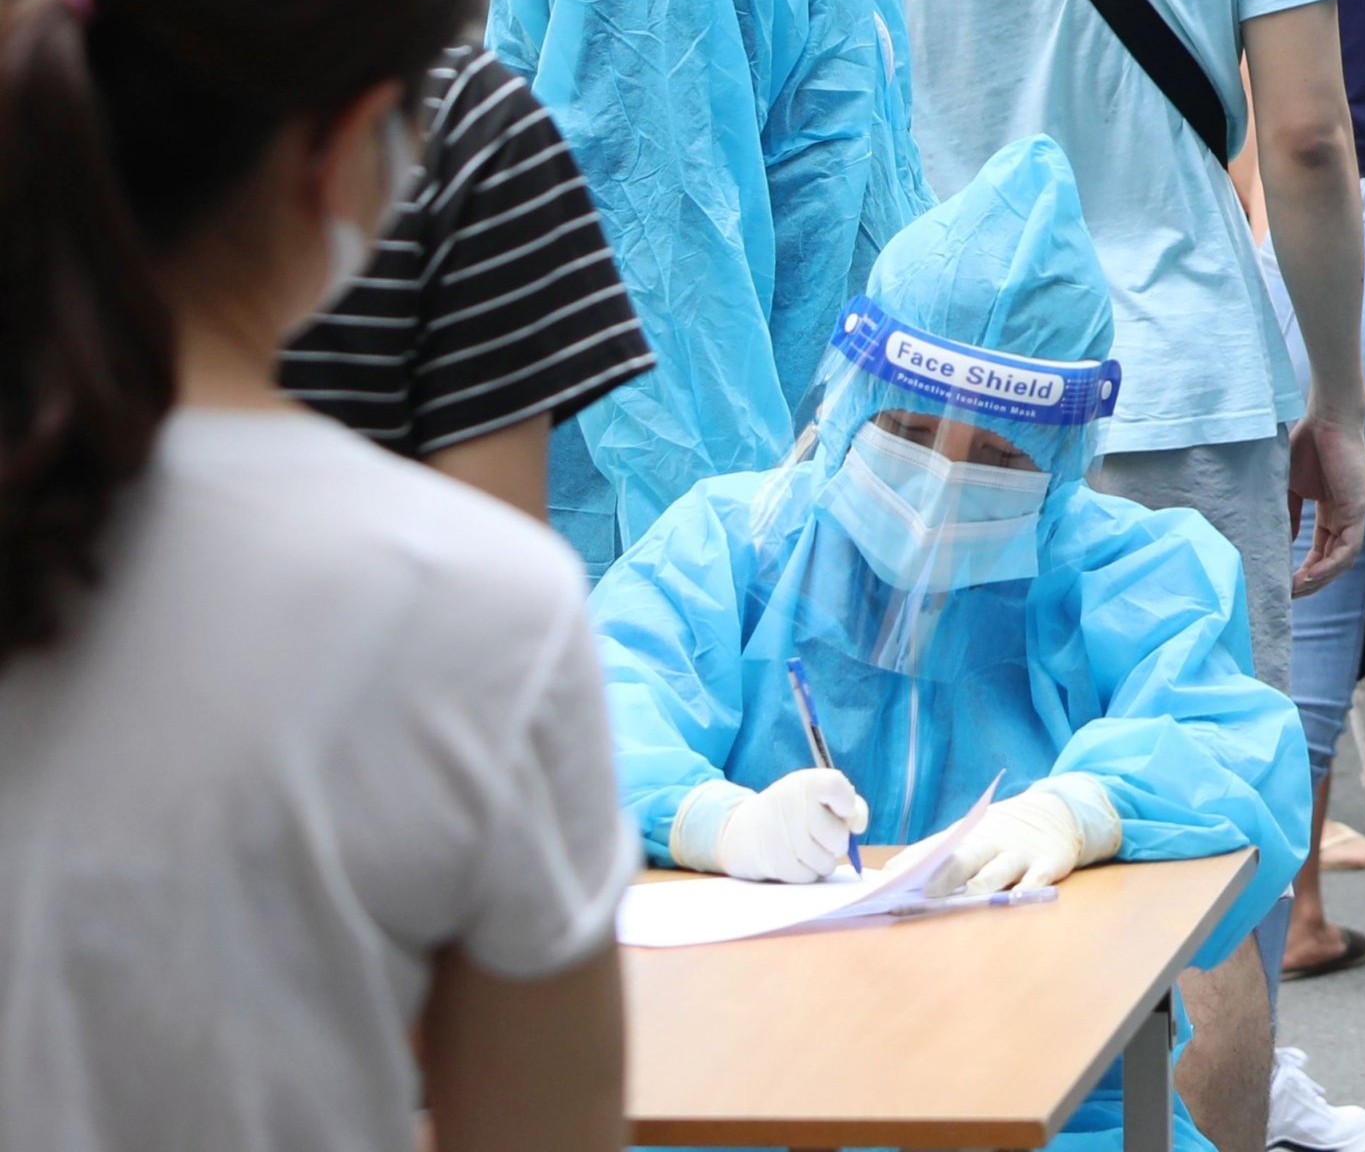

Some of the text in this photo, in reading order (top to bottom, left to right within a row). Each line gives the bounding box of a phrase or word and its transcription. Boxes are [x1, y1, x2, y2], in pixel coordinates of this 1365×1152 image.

[897, 341, 955, 377] Face
[966, 366, 1053, 399] Shield
[897, 372, 1036, 417] Protective Isolation Mask
